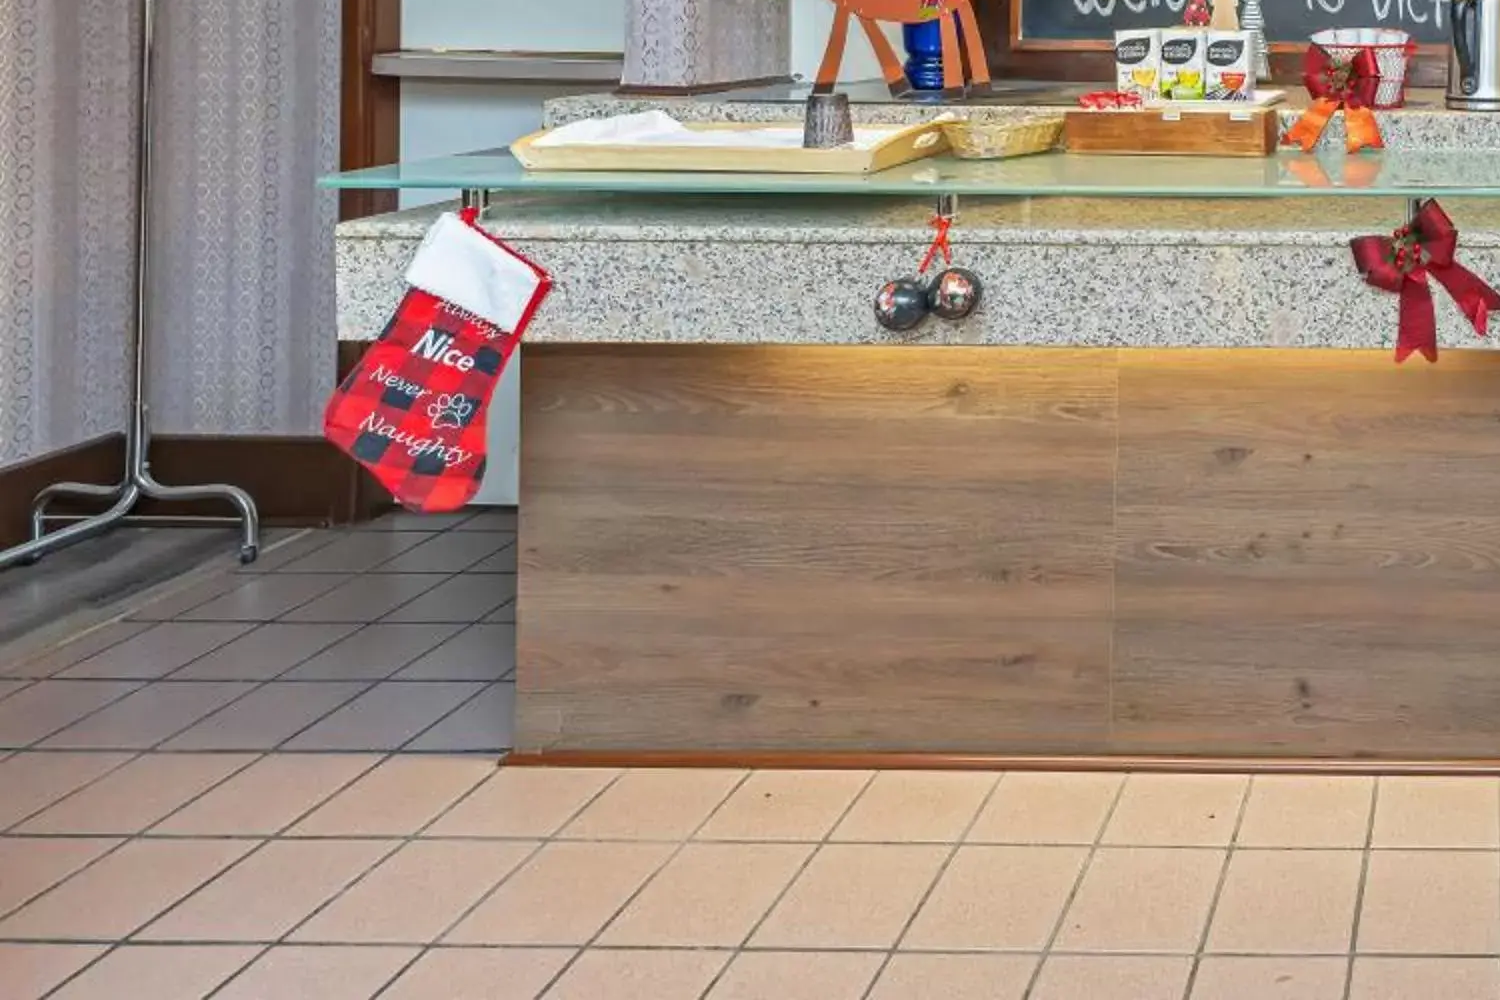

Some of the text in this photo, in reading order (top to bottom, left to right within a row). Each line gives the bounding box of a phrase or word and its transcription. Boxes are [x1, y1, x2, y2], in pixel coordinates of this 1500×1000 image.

[411, 326, 475, 372] Nice
[369, 364, 433, 399] Never
[358, 411, 473, 467] Naughty
